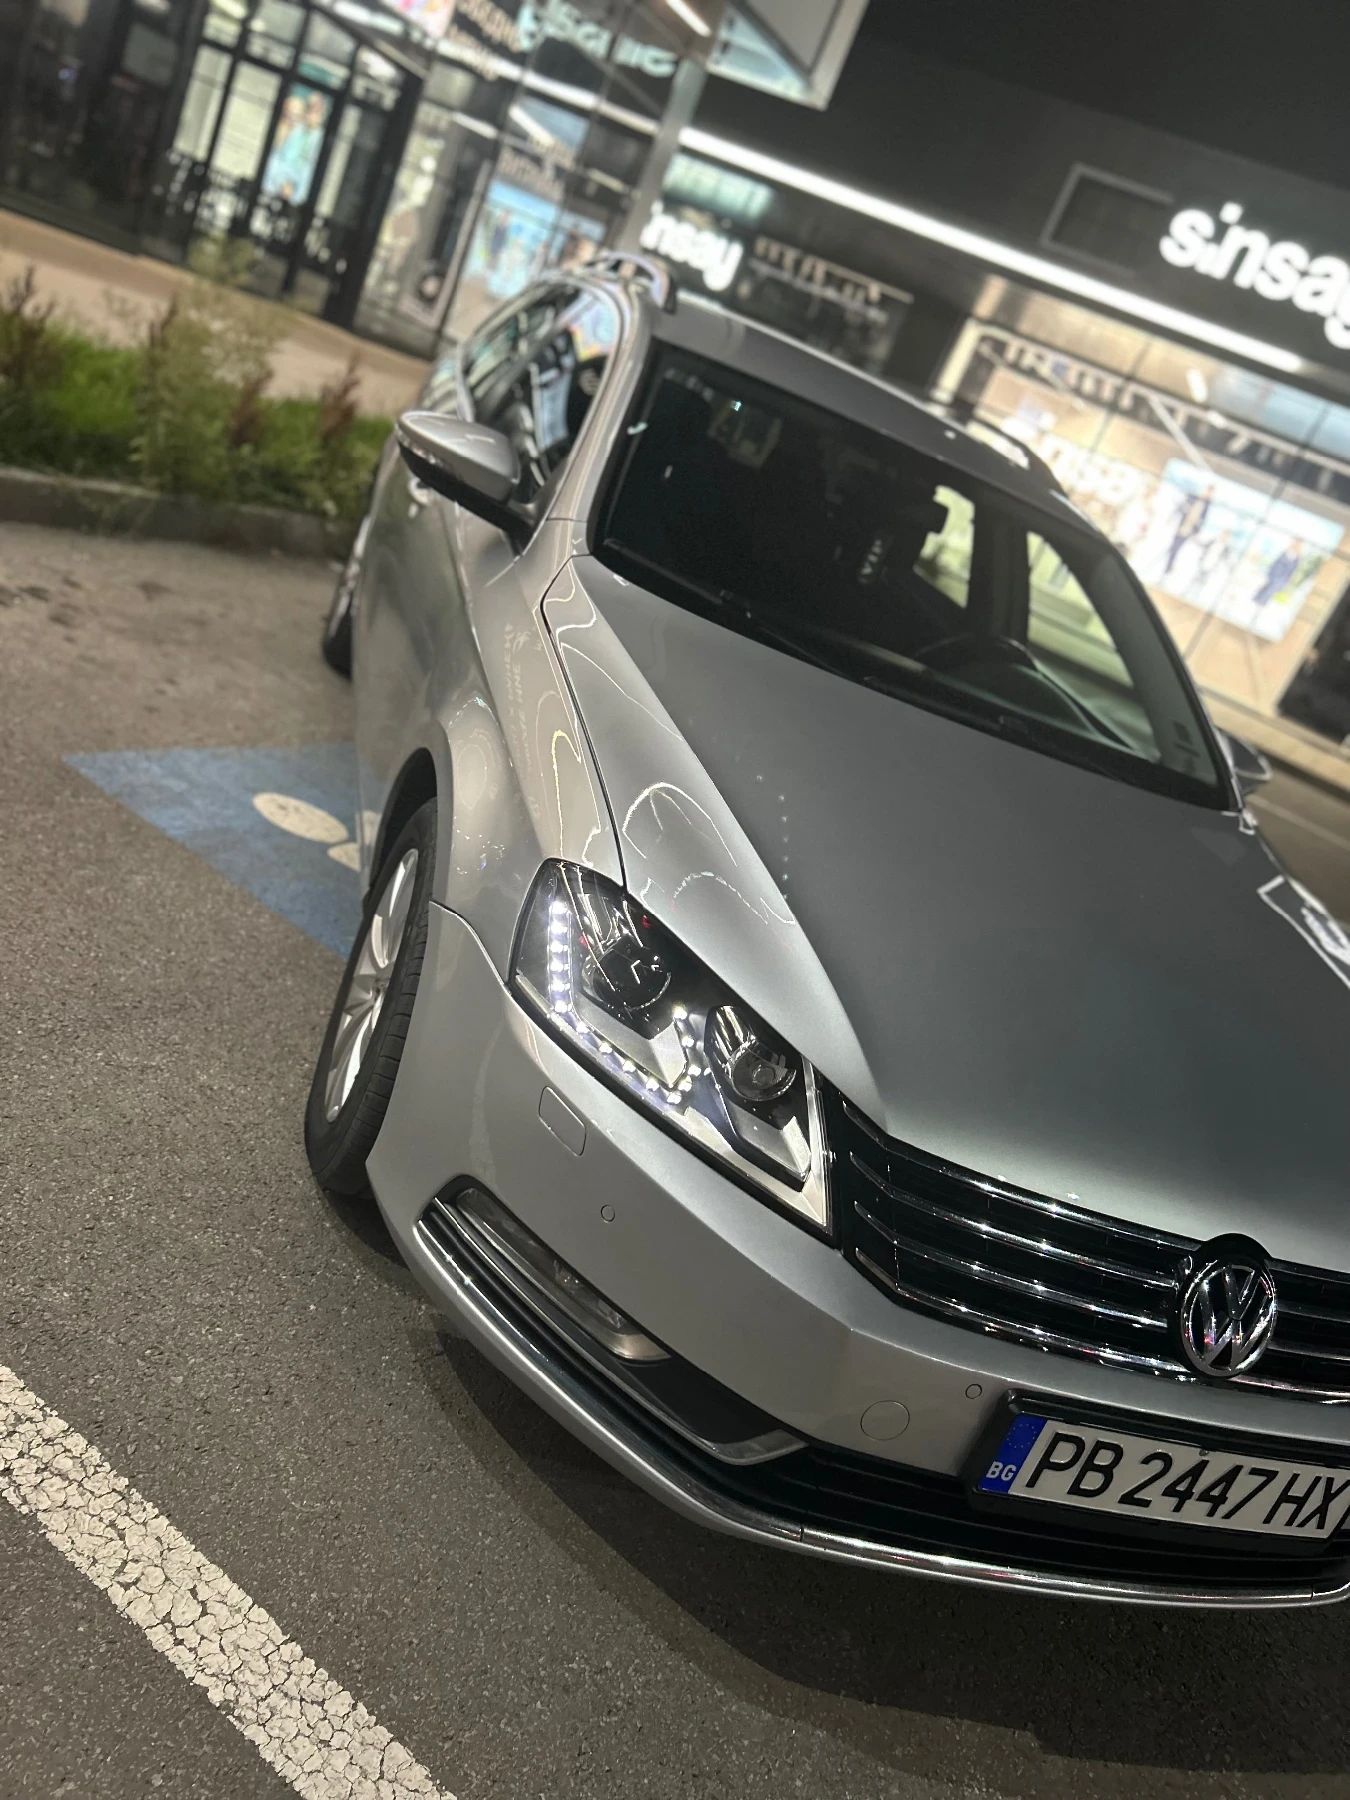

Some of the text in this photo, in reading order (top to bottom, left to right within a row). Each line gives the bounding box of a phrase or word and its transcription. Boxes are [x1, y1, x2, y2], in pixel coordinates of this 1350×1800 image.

[986, 1460, 1017, 1482] BG
[1026, 1431, 1350, 1530] PB 2447 HX
